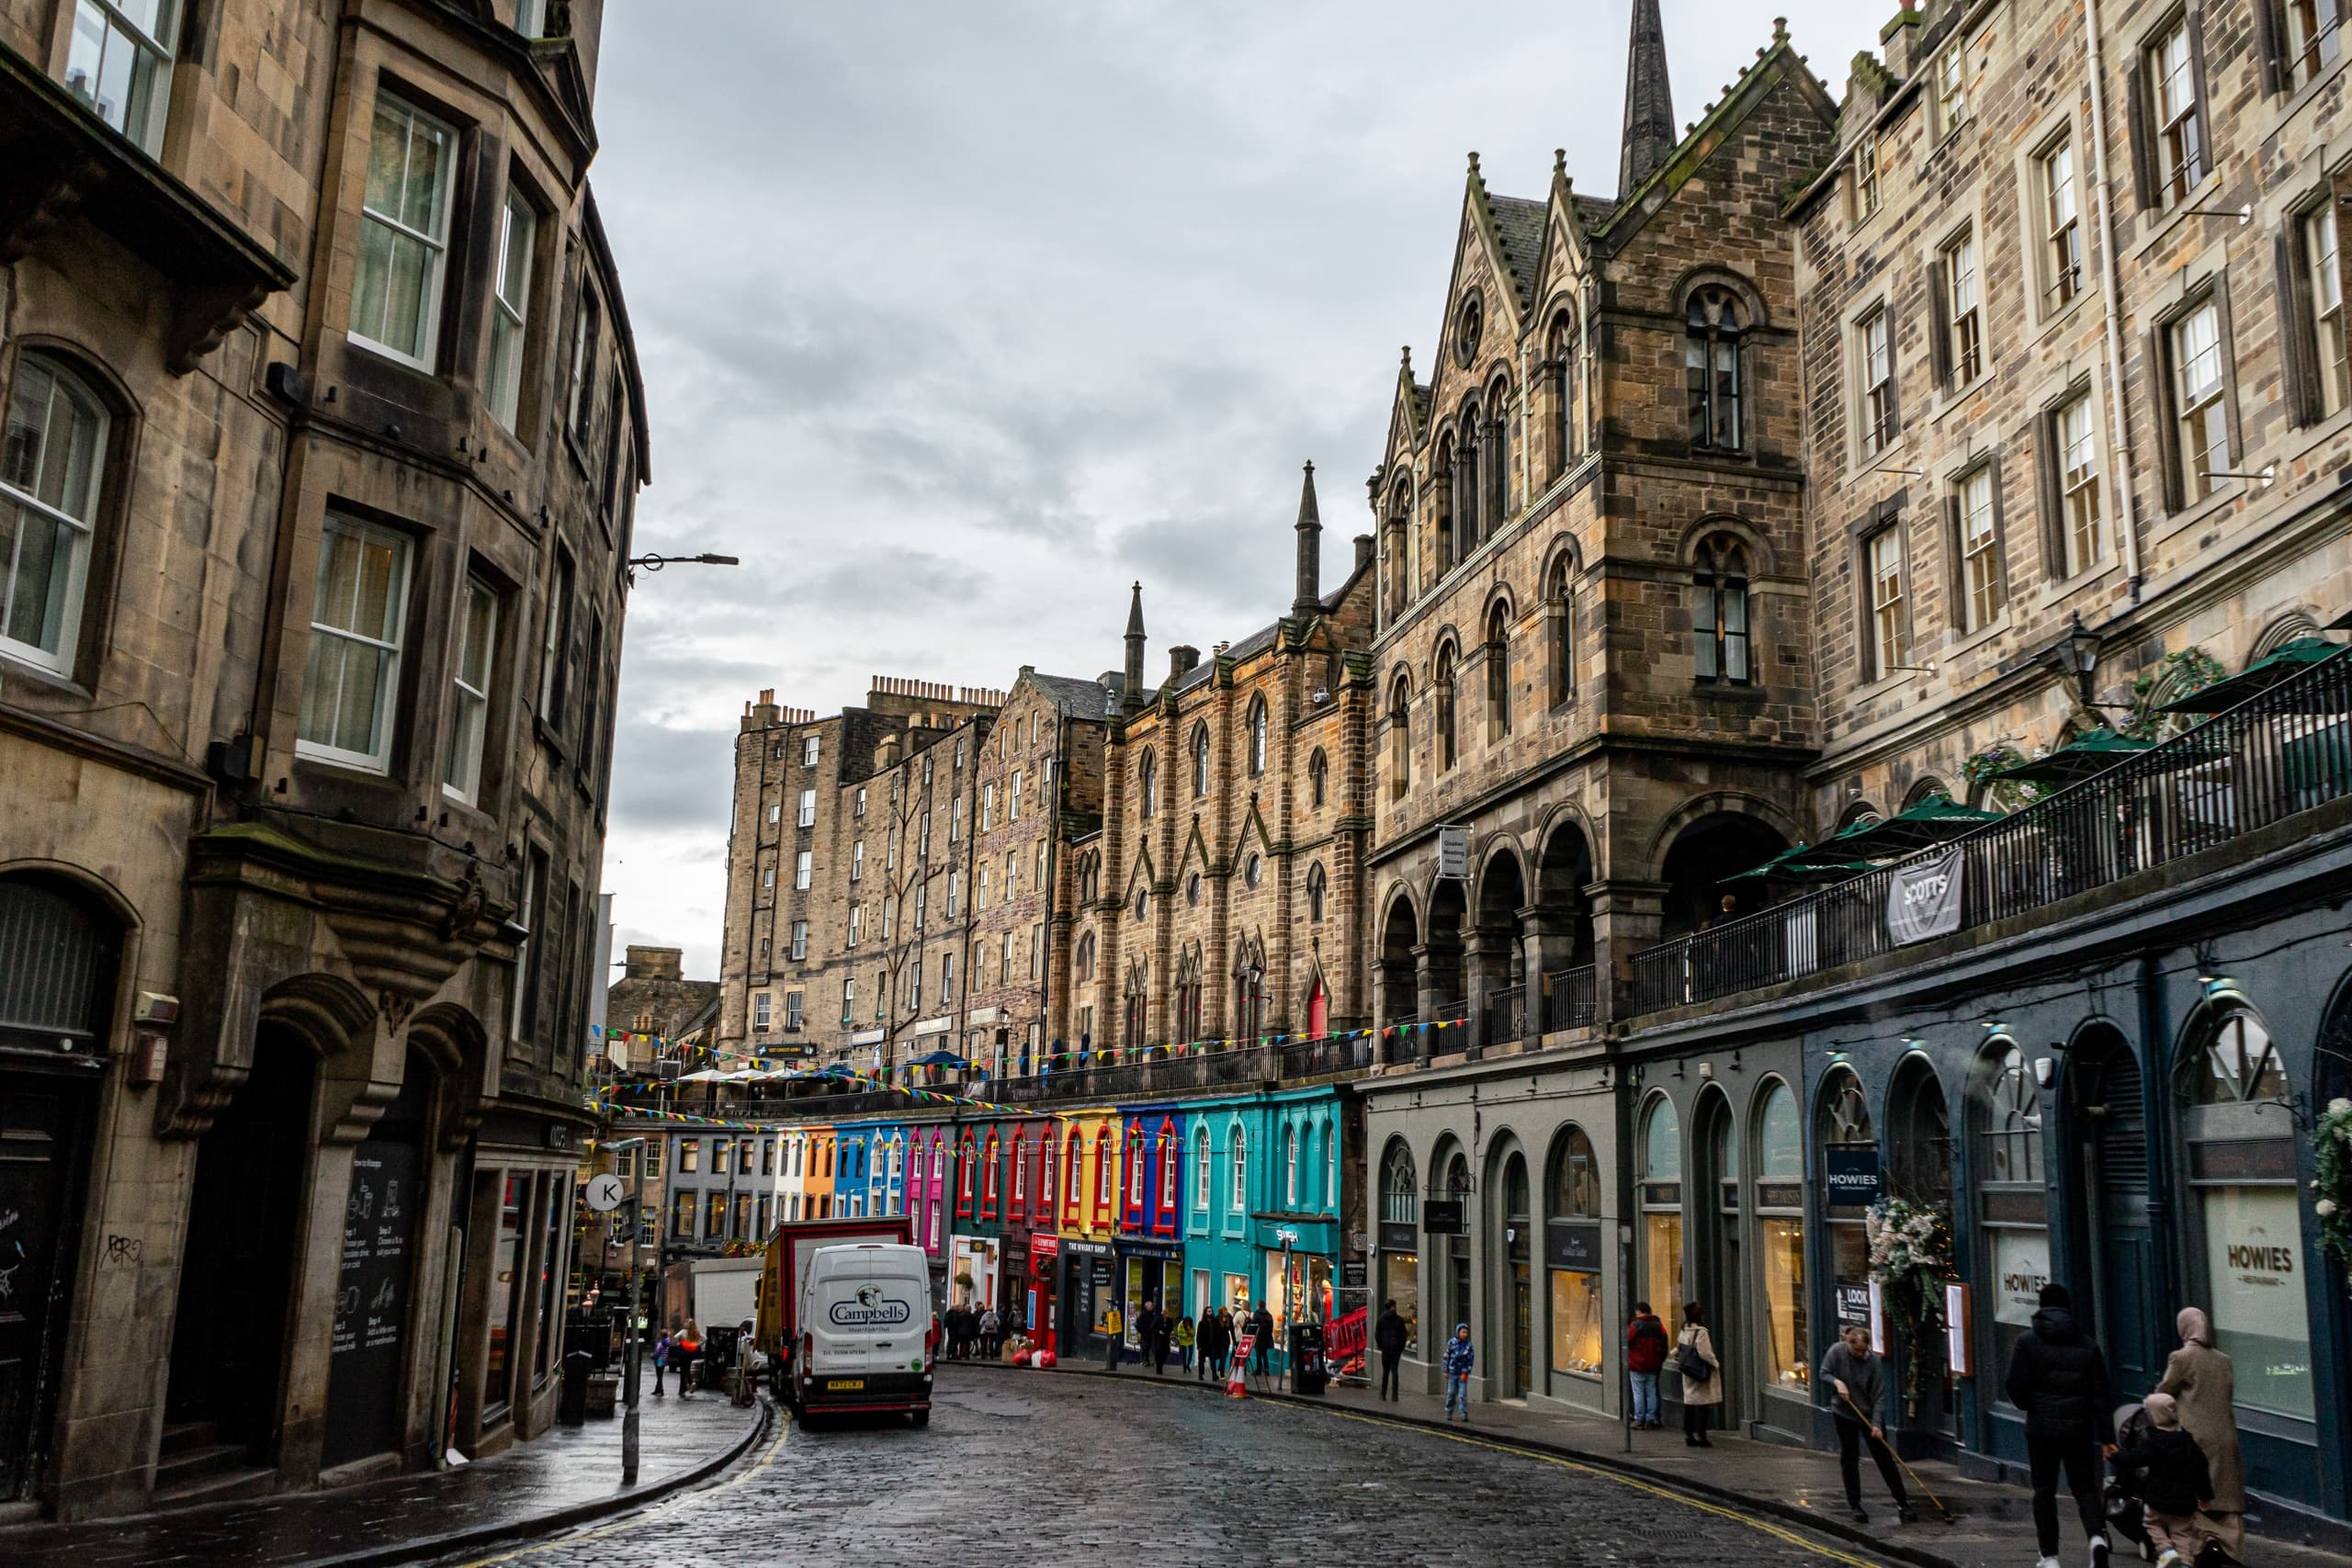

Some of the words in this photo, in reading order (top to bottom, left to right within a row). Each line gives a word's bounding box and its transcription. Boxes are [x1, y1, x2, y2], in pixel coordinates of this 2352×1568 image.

[1905, 874, 1948, 905] SCOTTS
[1828, 1174, 1878, 1185] HOWIES
[603, 1183, 617, 1201] K
[1069, 1242, 1077, 1250] THE
[1078, 1243, 1093, 1252] WHISKY
[1094, 1245, 1106, 1254] SHOP
[2228, 1245, 2293, 1272] HOWIES
[1847, 1288, 1869, 1304] LOOK
[834, 1306, 904, 1323] Campbells
